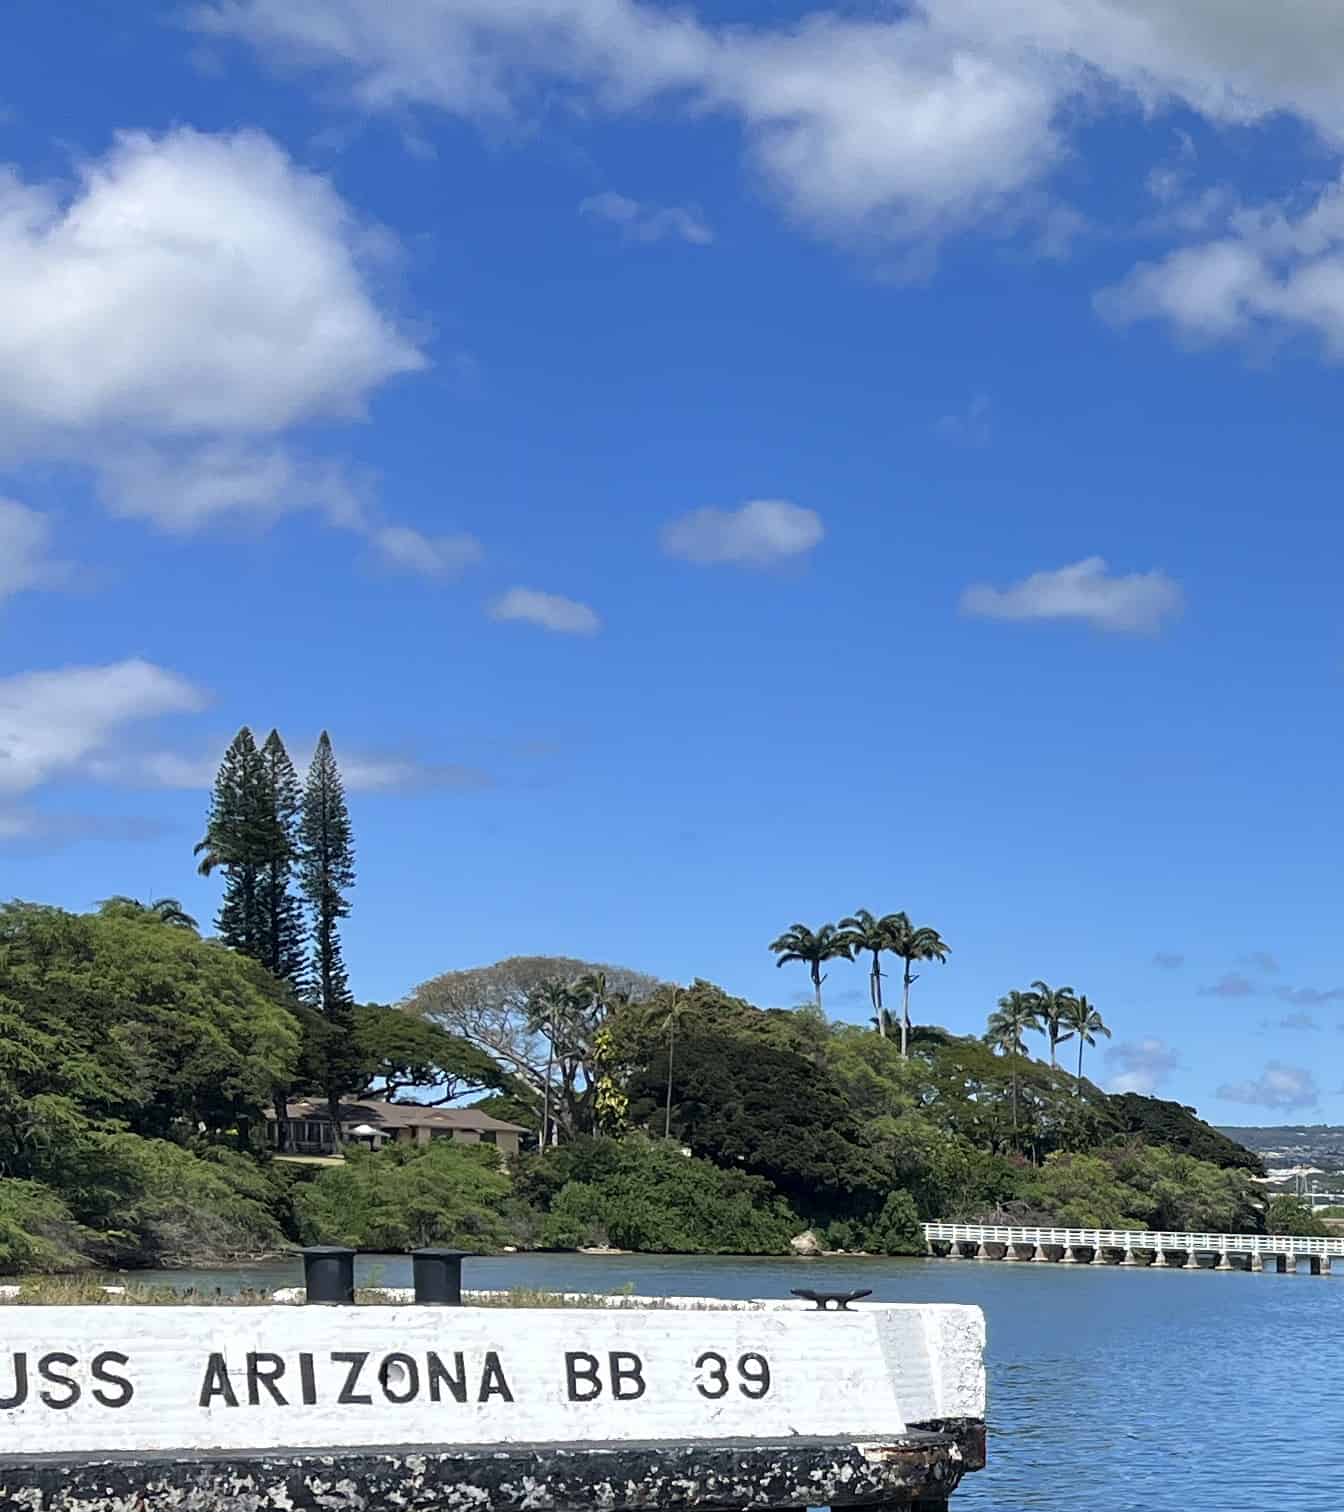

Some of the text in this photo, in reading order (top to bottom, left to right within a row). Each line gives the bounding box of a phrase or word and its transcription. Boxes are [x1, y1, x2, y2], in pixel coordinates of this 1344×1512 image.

[198, 1351, 515, 1407] ARIZONA
[564, 1351, 646, 1401] BB
[695, 1351, 771, 1400] 39
